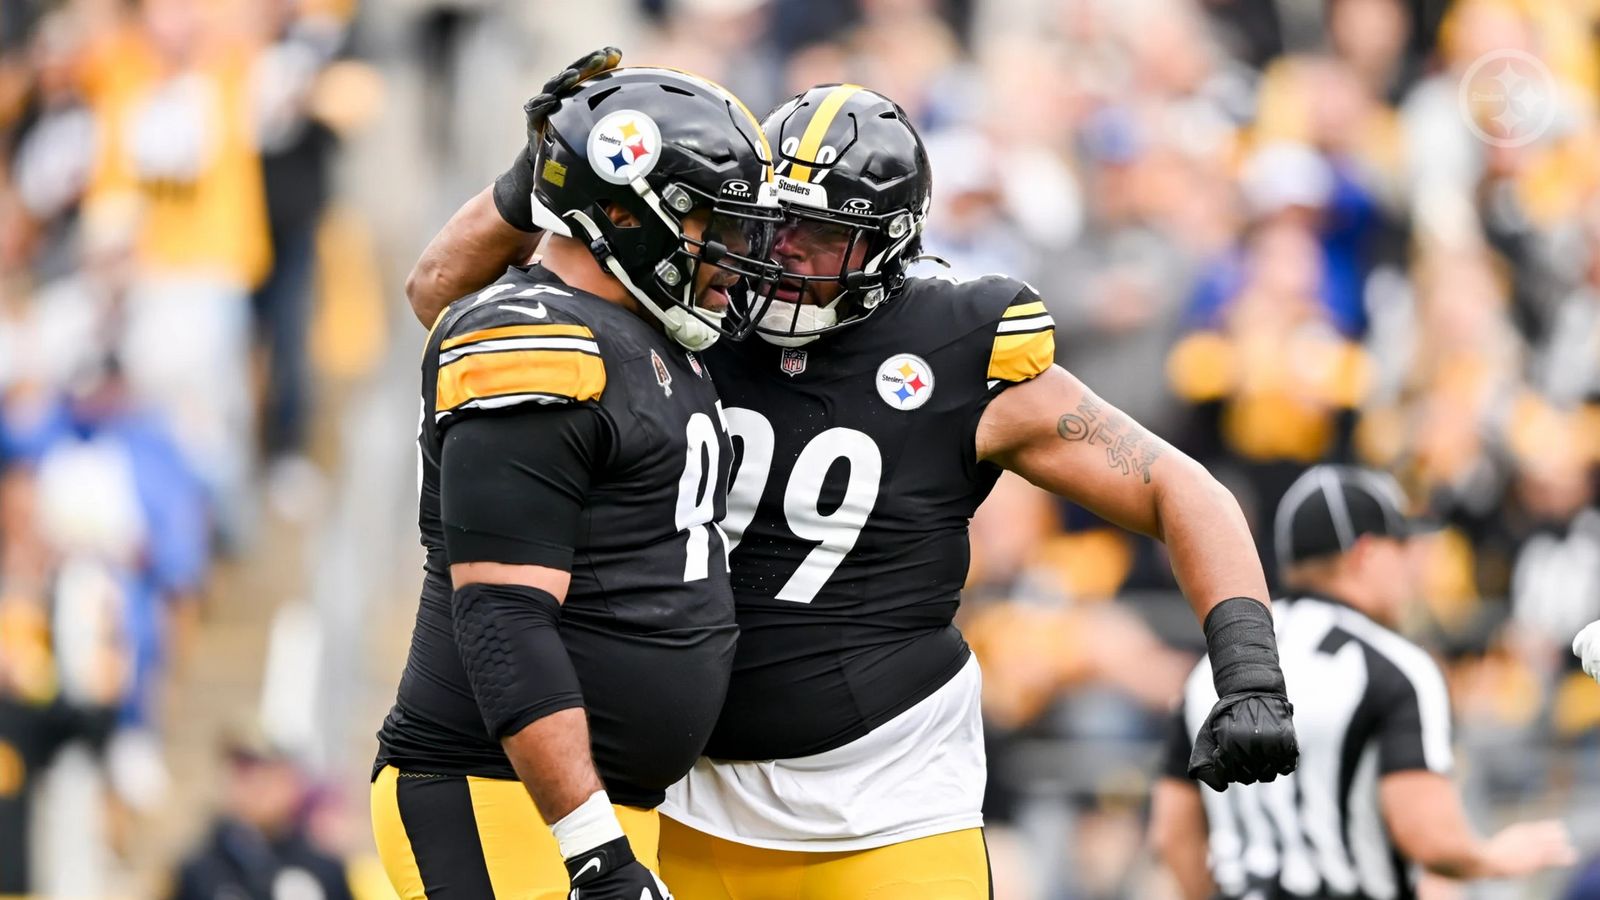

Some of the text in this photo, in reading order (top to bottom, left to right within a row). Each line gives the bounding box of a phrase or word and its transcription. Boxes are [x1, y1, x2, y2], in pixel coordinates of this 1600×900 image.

[598, 134, 621, 147] Steelers
[722, 188, 752, 198] OAKLEY
[778, 180, 811, 196] Steelers
[783, 359, 803, 372] NFL
[882, 374, 904, 384] Steelers
